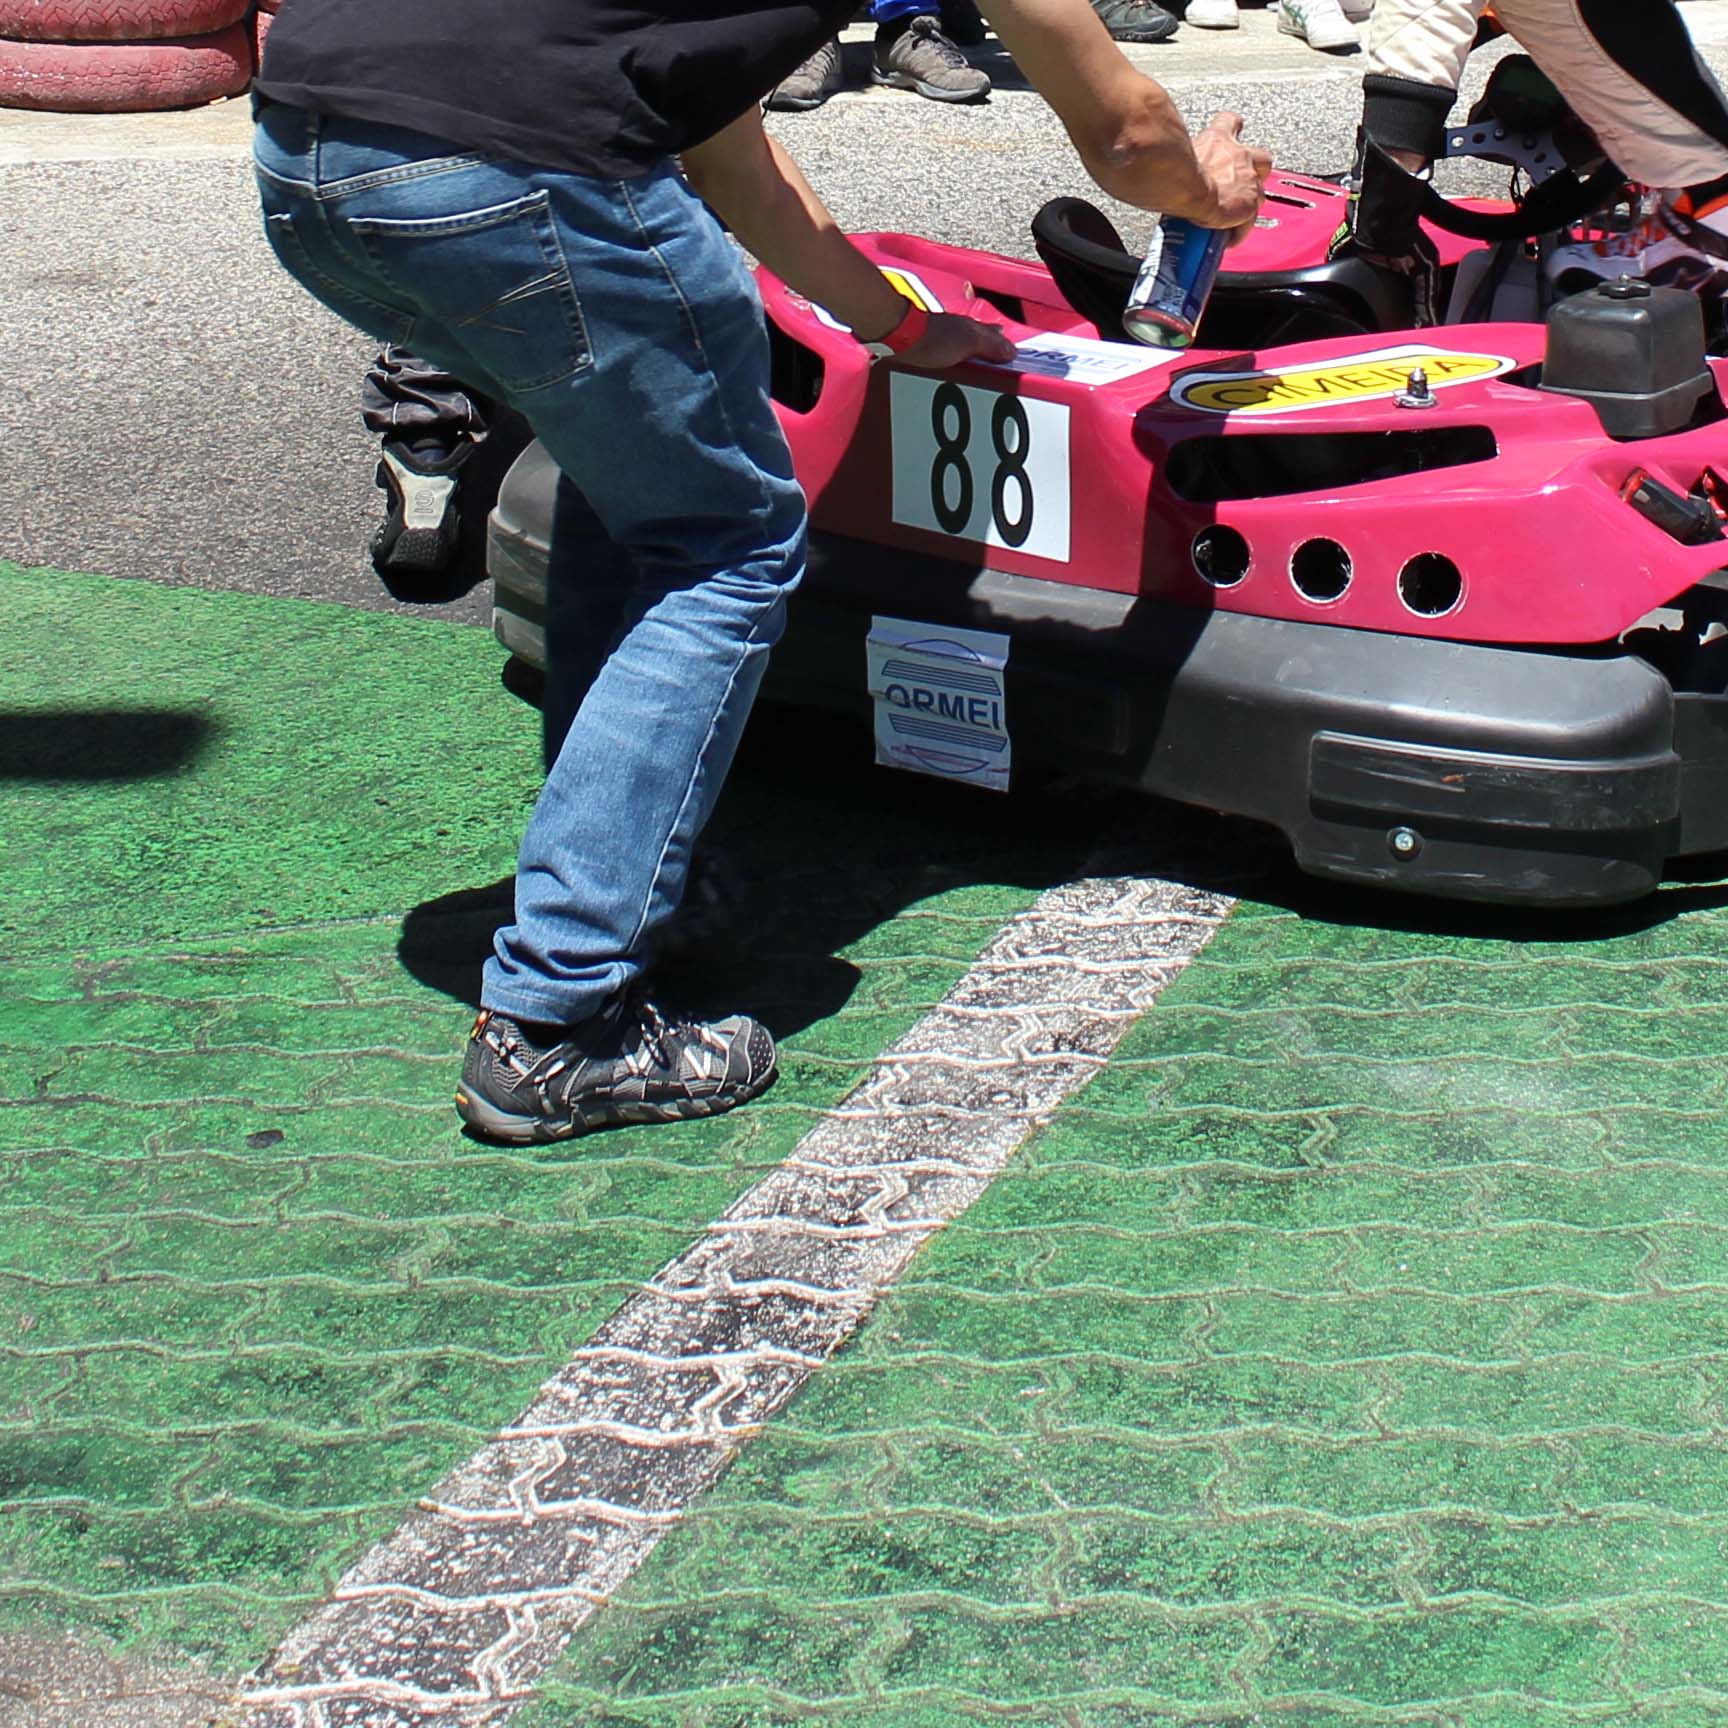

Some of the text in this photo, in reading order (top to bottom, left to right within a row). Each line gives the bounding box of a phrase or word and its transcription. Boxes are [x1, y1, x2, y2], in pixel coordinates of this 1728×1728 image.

[1211, 358, 1486, 406] CIMEIRA
[931, 382, 1035, 548] 88
[884, 683, 1002, 731] ORMEI
